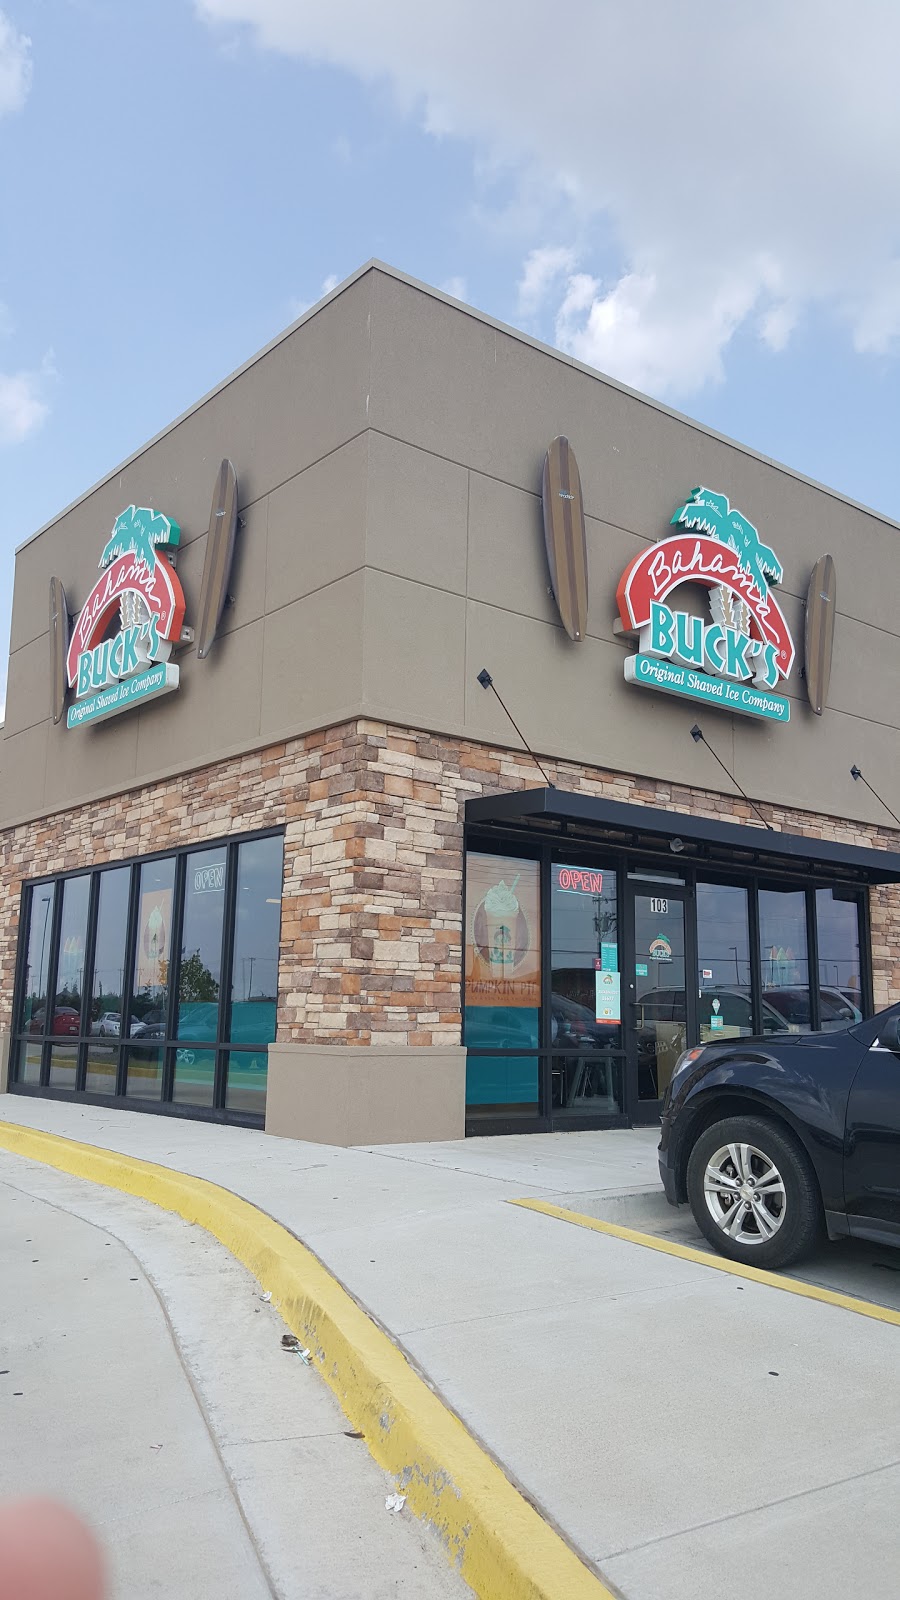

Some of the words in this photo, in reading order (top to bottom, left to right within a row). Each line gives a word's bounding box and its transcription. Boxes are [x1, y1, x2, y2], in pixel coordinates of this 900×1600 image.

[78, 562, 161, 648] Bahama
[648, 541, 780, 644] Bahama
[76, 612, 160, 698] BUCK'S
[650, 599, 780, 689] BUCK'S
[71, 699, 95, 720] Original
[96, 687, 119, 710] Shaved
[119, 684, 129, 701] Ice
[131, 670, 163, 694] Company
[640, 659, 685, 684] Original
[687, 674, 723, 696] Shaved
[725, 685, 740, 701] Ice
[742, 690, 785, 716] Company
[195, 867, 223, 890] OPEN
[559, 868, 602, 893] OPEN
[652, 898, 667, 913] 103
[465, 979, 515, 995] PUMPKIN
